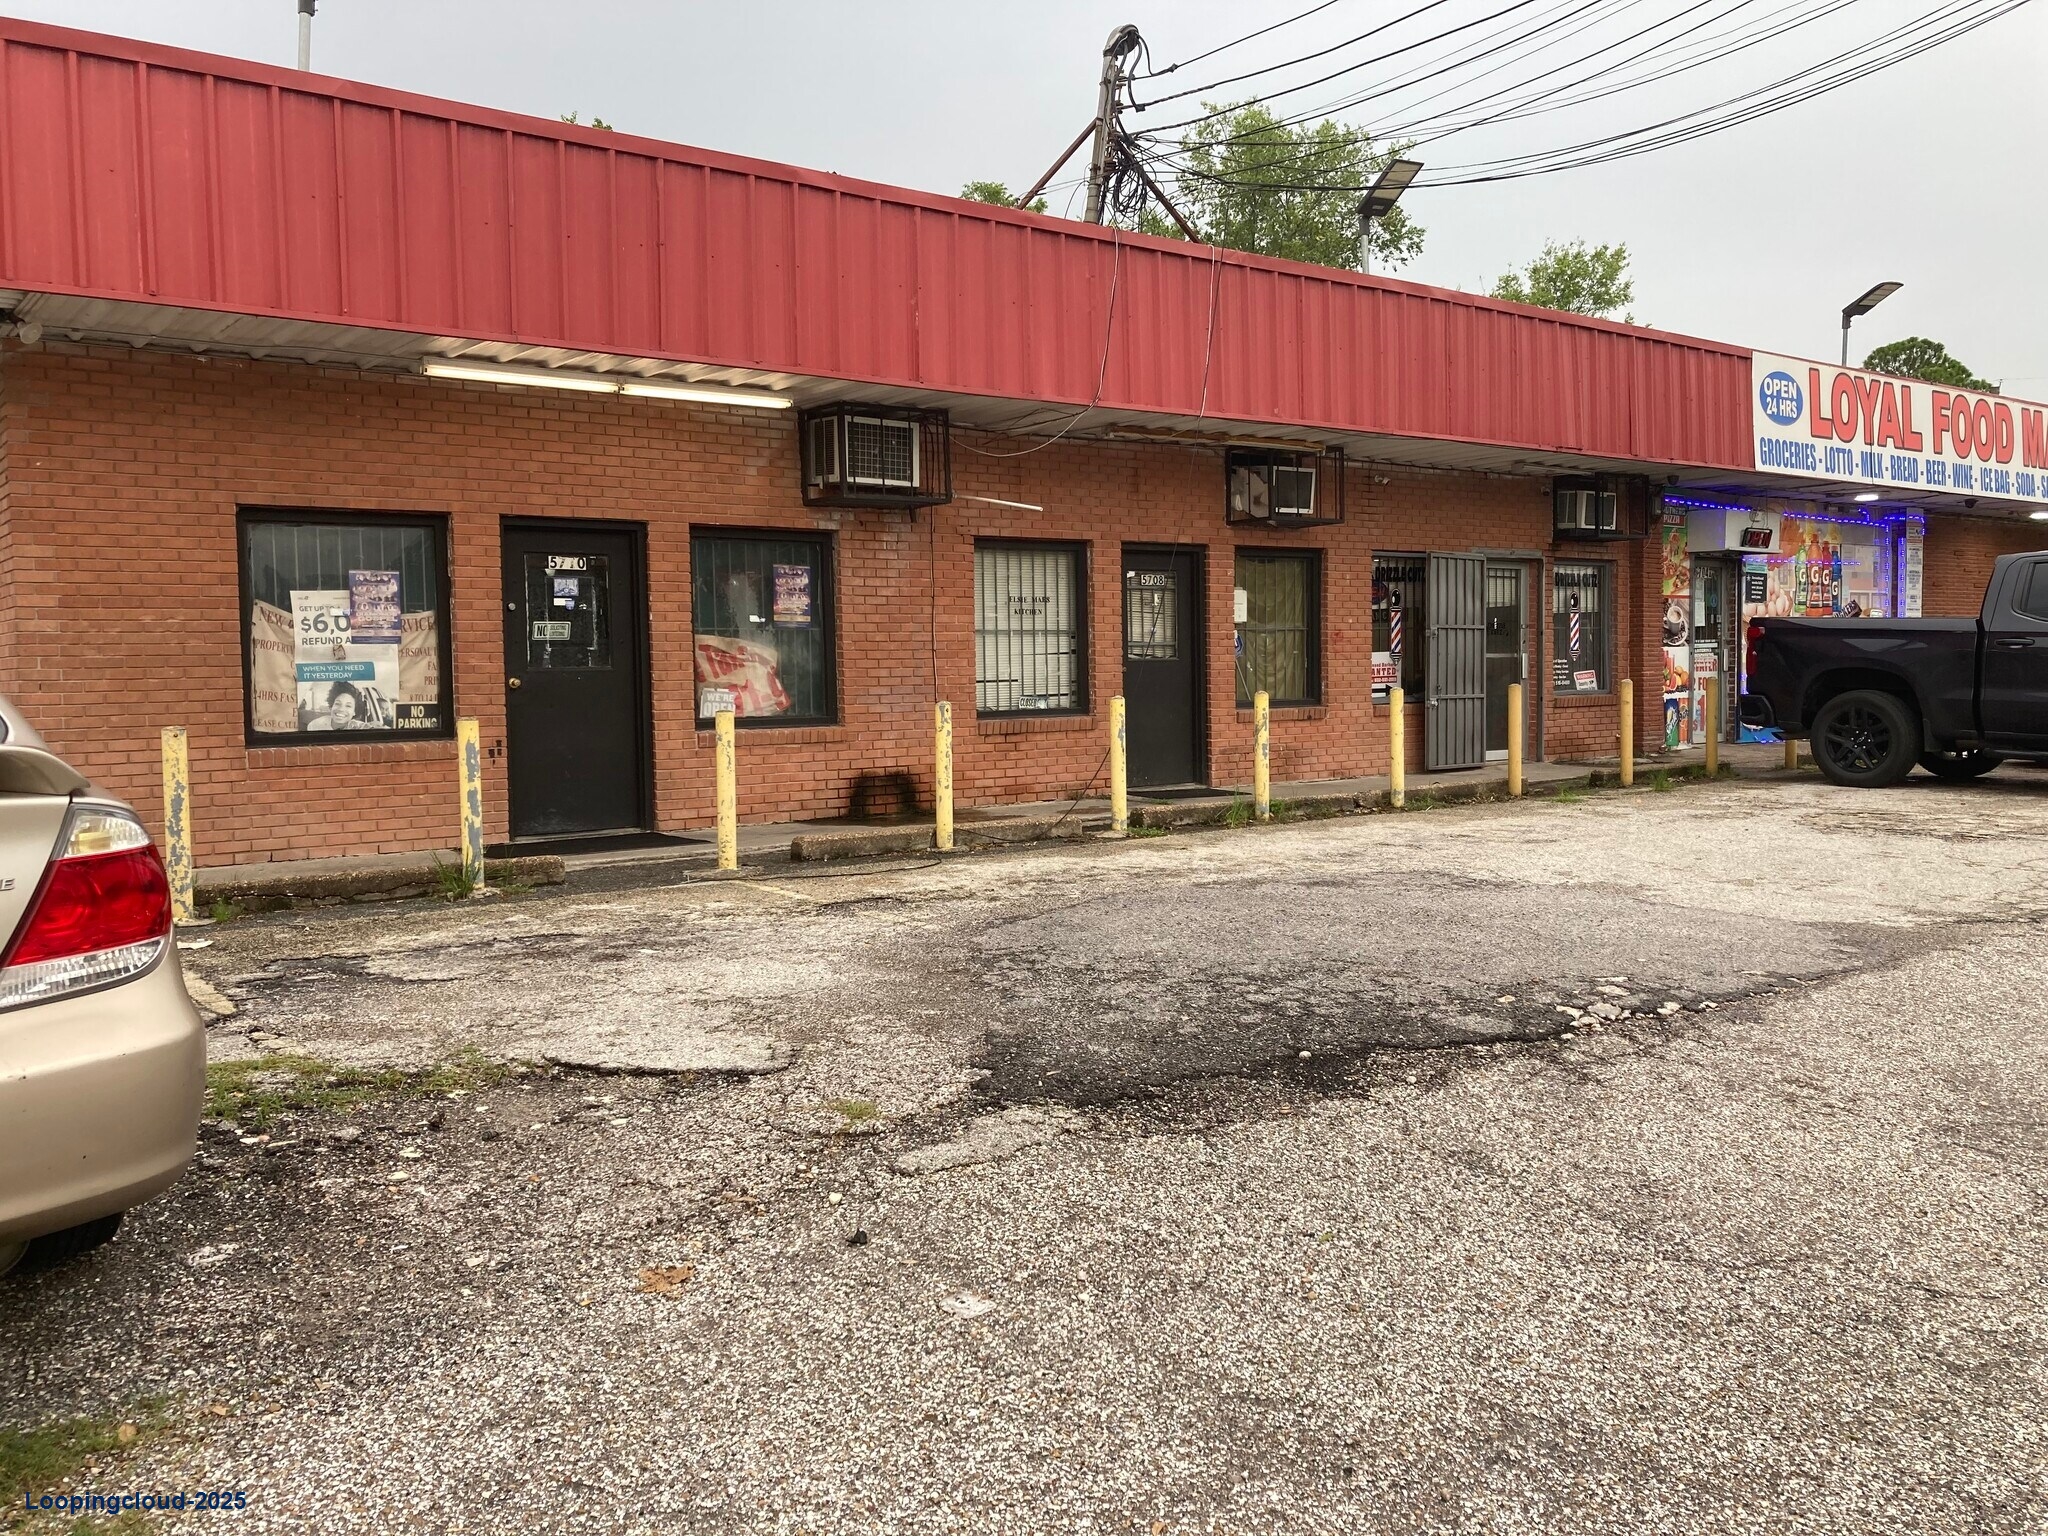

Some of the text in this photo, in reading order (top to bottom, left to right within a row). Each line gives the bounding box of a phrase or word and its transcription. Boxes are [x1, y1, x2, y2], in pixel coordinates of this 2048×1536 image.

[1764, 378, 1797, 399] OPEN
[1767, 400, 1797, 418] 24 HRS
[1809, 368, 2048, 470] LOYAL FOOD M
[1760, 437, 1816, 472] GROCERIES
[1825, 446, 1853, 476] LOTTO
[1861, 451, 1884, 479] MILK
[1890, 455, 1919, 483] BREAD
[1926, 460, 1947, 486] BEER
[1953, 463, 1973, 489] WINE
[1980, 467, 1993, 492] ICE
[1994, 469, 2010, 494] BAG
[2016, 472, 2036, 497] SODA
[1663, 515, 1680, 524] PIZZA
[1142, 575, 1164, 586] 5708
[1800, 569, 1806, 582] G
[1811, 566, 1819, 583] G
[1823, 570, 1830, 584] G
[1832, 582, 1838, 596] G
[301, 613, 351, 634] $6,0
[302, 637, 342, 645] REFUND
[707, 693, 734, 702] WE'RE
[411, 706, 424, 717] NO
[398, 718, 437, 728] PARKING
[0, 878, 15, 891] E
